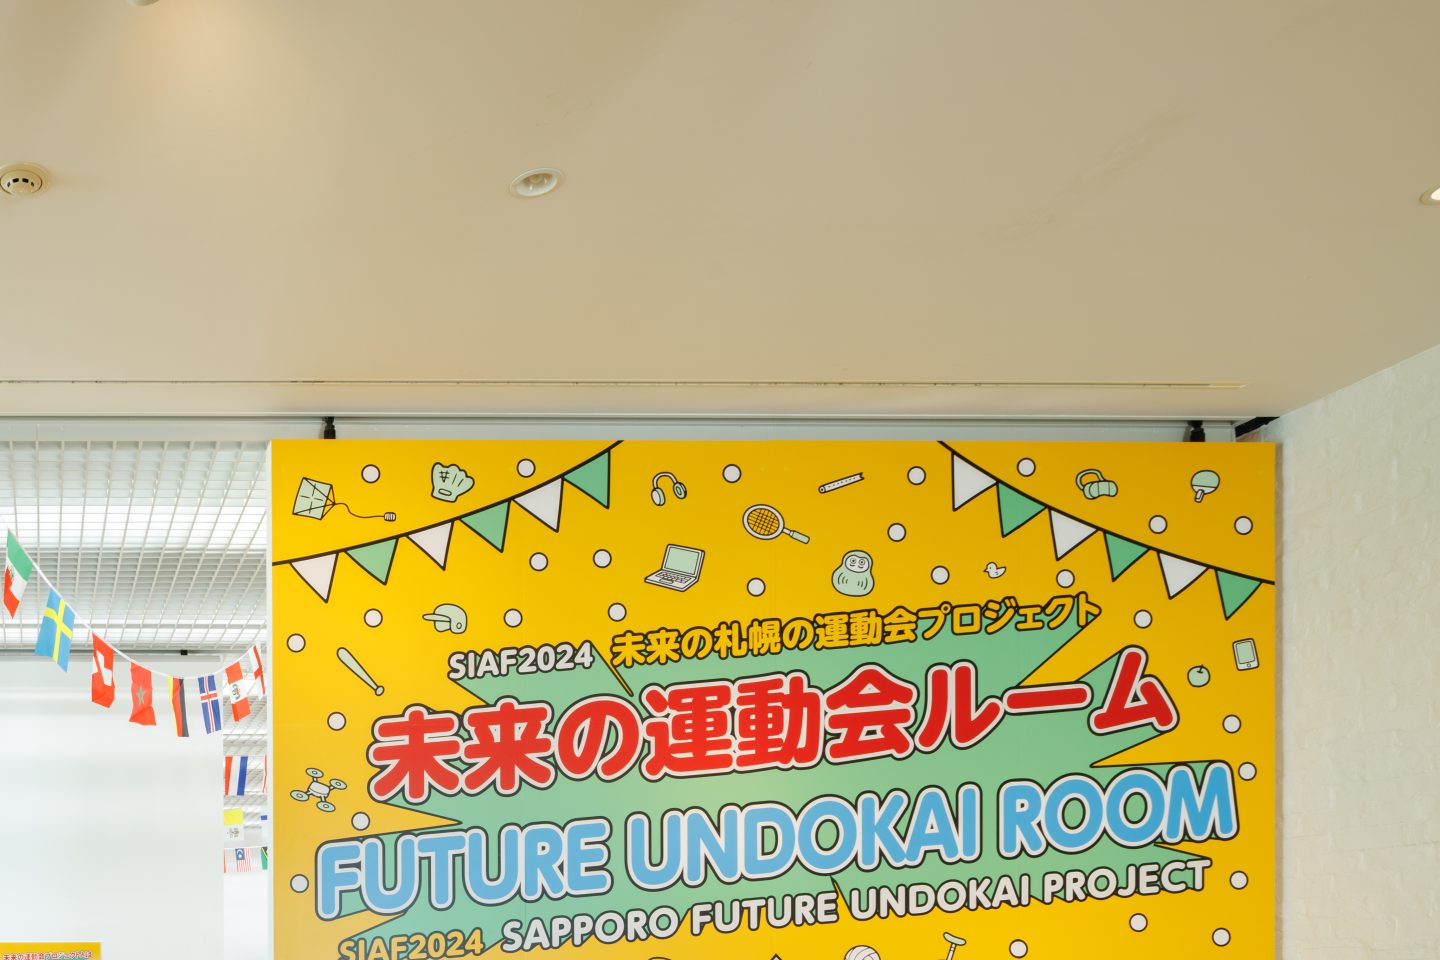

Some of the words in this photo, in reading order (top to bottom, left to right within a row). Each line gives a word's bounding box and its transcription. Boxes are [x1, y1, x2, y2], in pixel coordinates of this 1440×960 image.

[449, 641, 594, 680] SIAF2024
[610, 592, 1101, 668] 未来の札幌の運動会プロジェクト
[369, 645, 1179, 805] 未来の運動会ルーム
[316, 817, 613, 919] FUTURE
[625, 782, 982, 891] UNDOKAI
[997, 761, 1240, 858] ROOM
[502, 907, 680, 952] SAPPORO
[691, 891, 839, 936] FUTURE
[850, 873, 1030, 920] UNDOKAI
[1044, 857, 1213, 903] PROJECT
